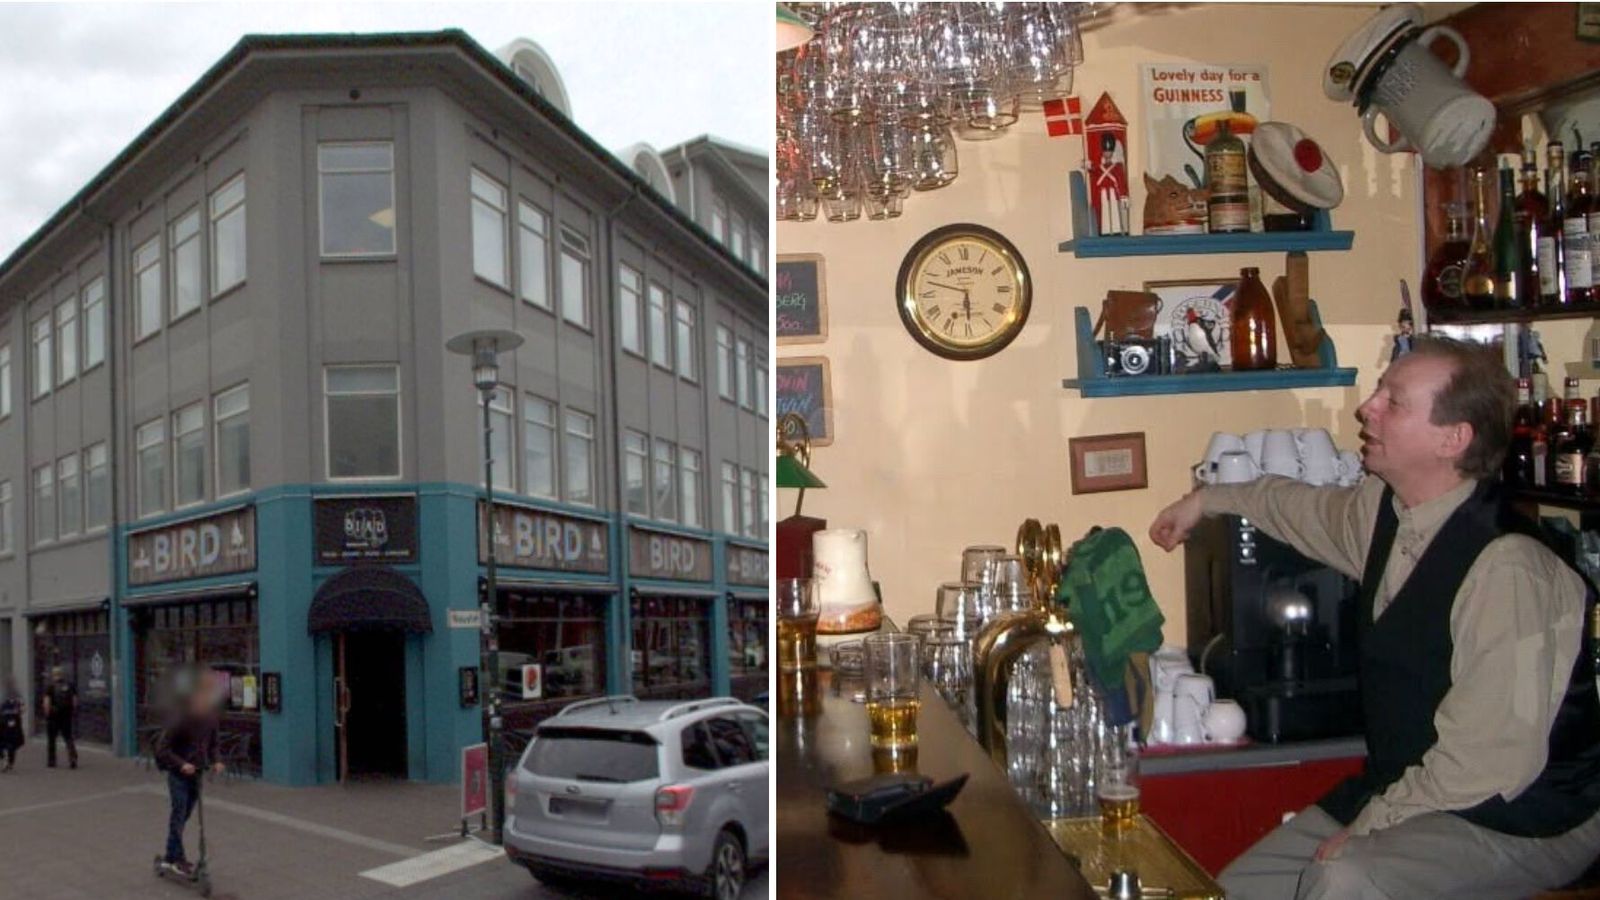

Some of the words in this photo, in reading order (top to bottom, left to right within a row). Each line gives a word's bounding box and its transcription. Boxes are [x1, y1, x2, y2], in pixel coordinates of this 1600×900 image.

[1152, 67, 1196, 83] Lovely
[1200, 68, 1224, 83] day
[1228, 68, 1249, 81] for
[1251, 72, 1260, 81] a
[1153, 86, 1224, 102] GUINNESS
[946, 266, 984, 278] JAMESON
[154, 523, 220, 573] BIRD
[514, 511, 581, 561] BIRD
[650, 536, 694, 573] BIRD
